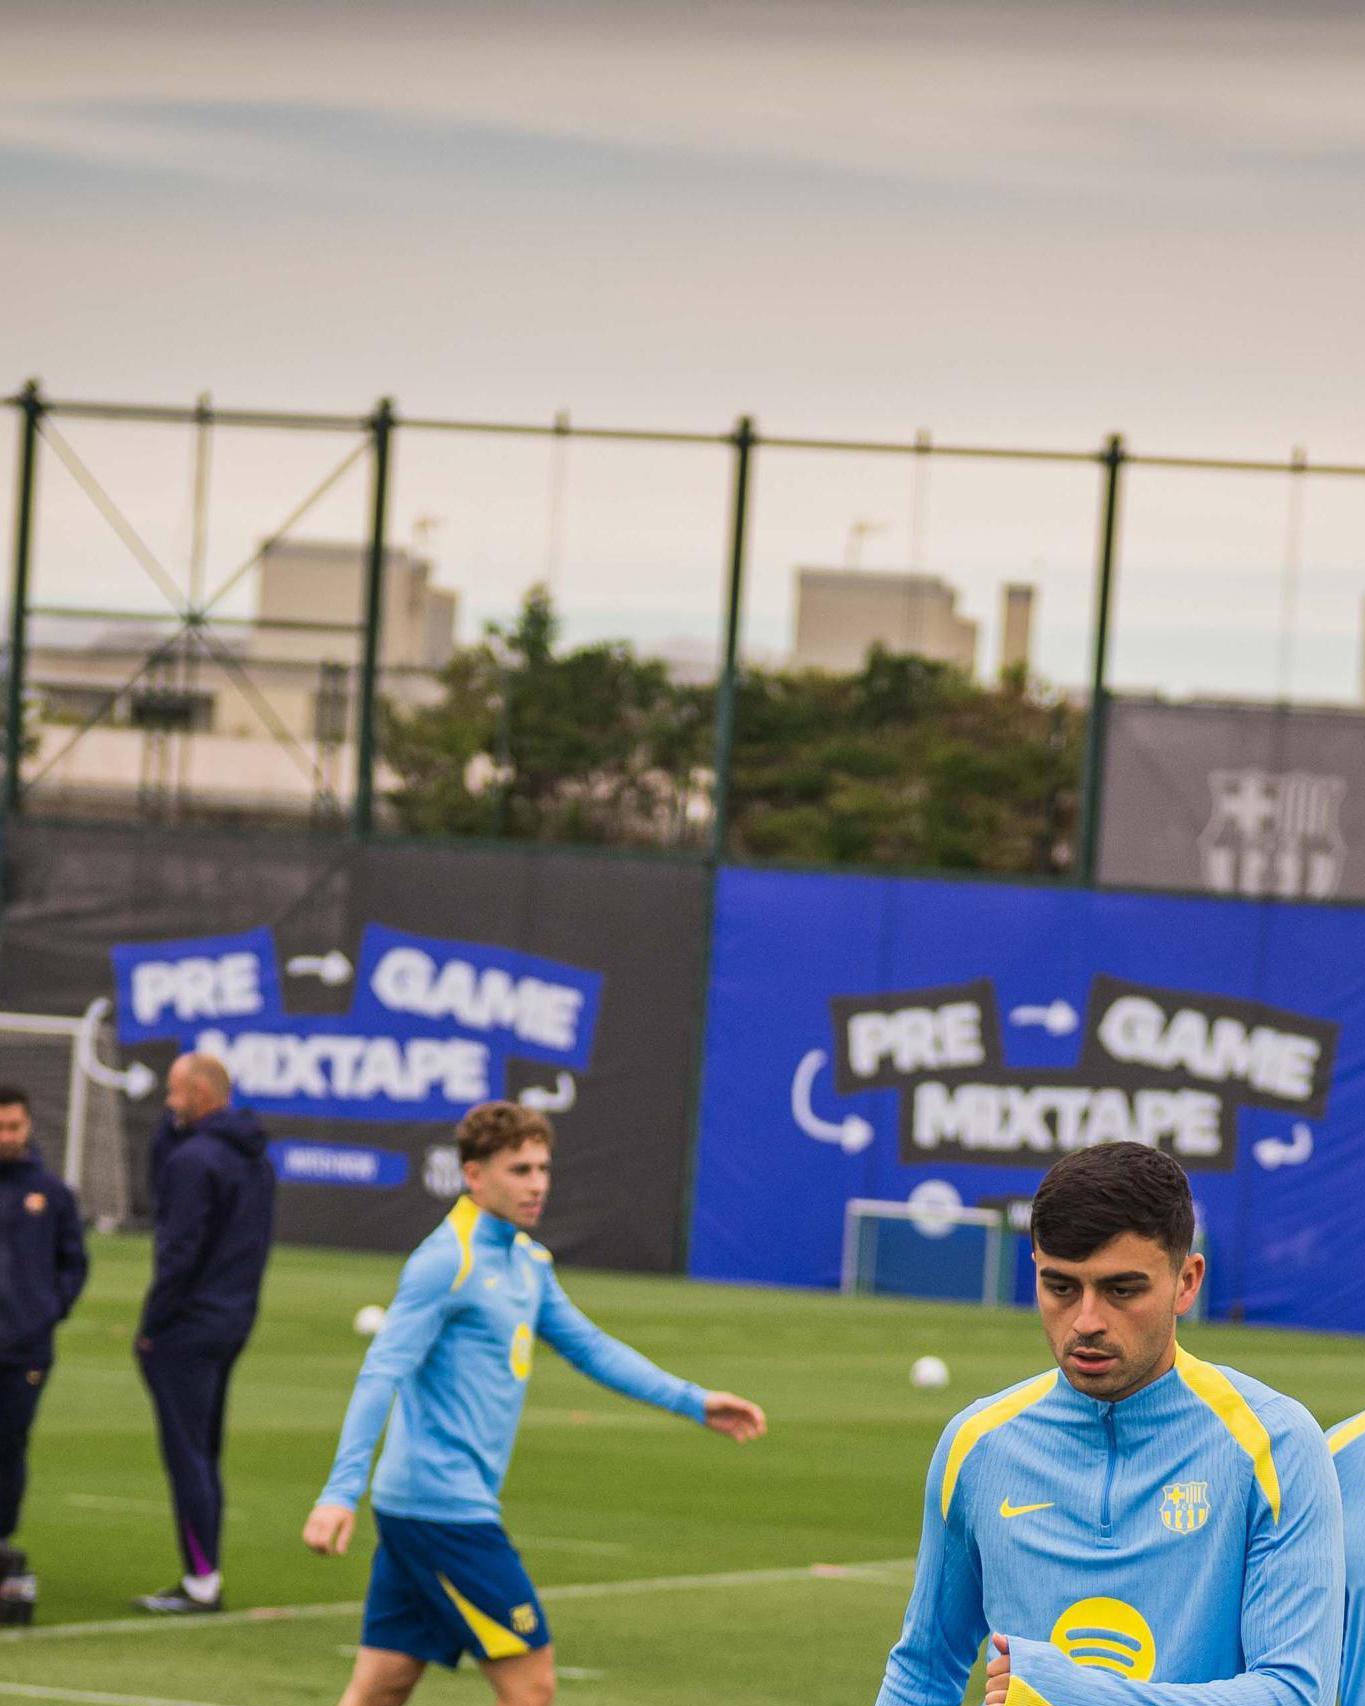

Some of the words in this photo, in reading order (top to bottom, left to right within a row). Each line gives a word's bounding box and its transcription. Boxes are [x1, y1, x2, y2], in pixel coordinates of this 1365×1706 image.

[132, 953, 264, 1023] PRE
[372, 947, 584, 1051] GAME
[847, 1002, 985, 1077] PRE
[1099, 996, 1320, 1099] GAME
[912, 1082, 1221, 1156] MIXTAPE
